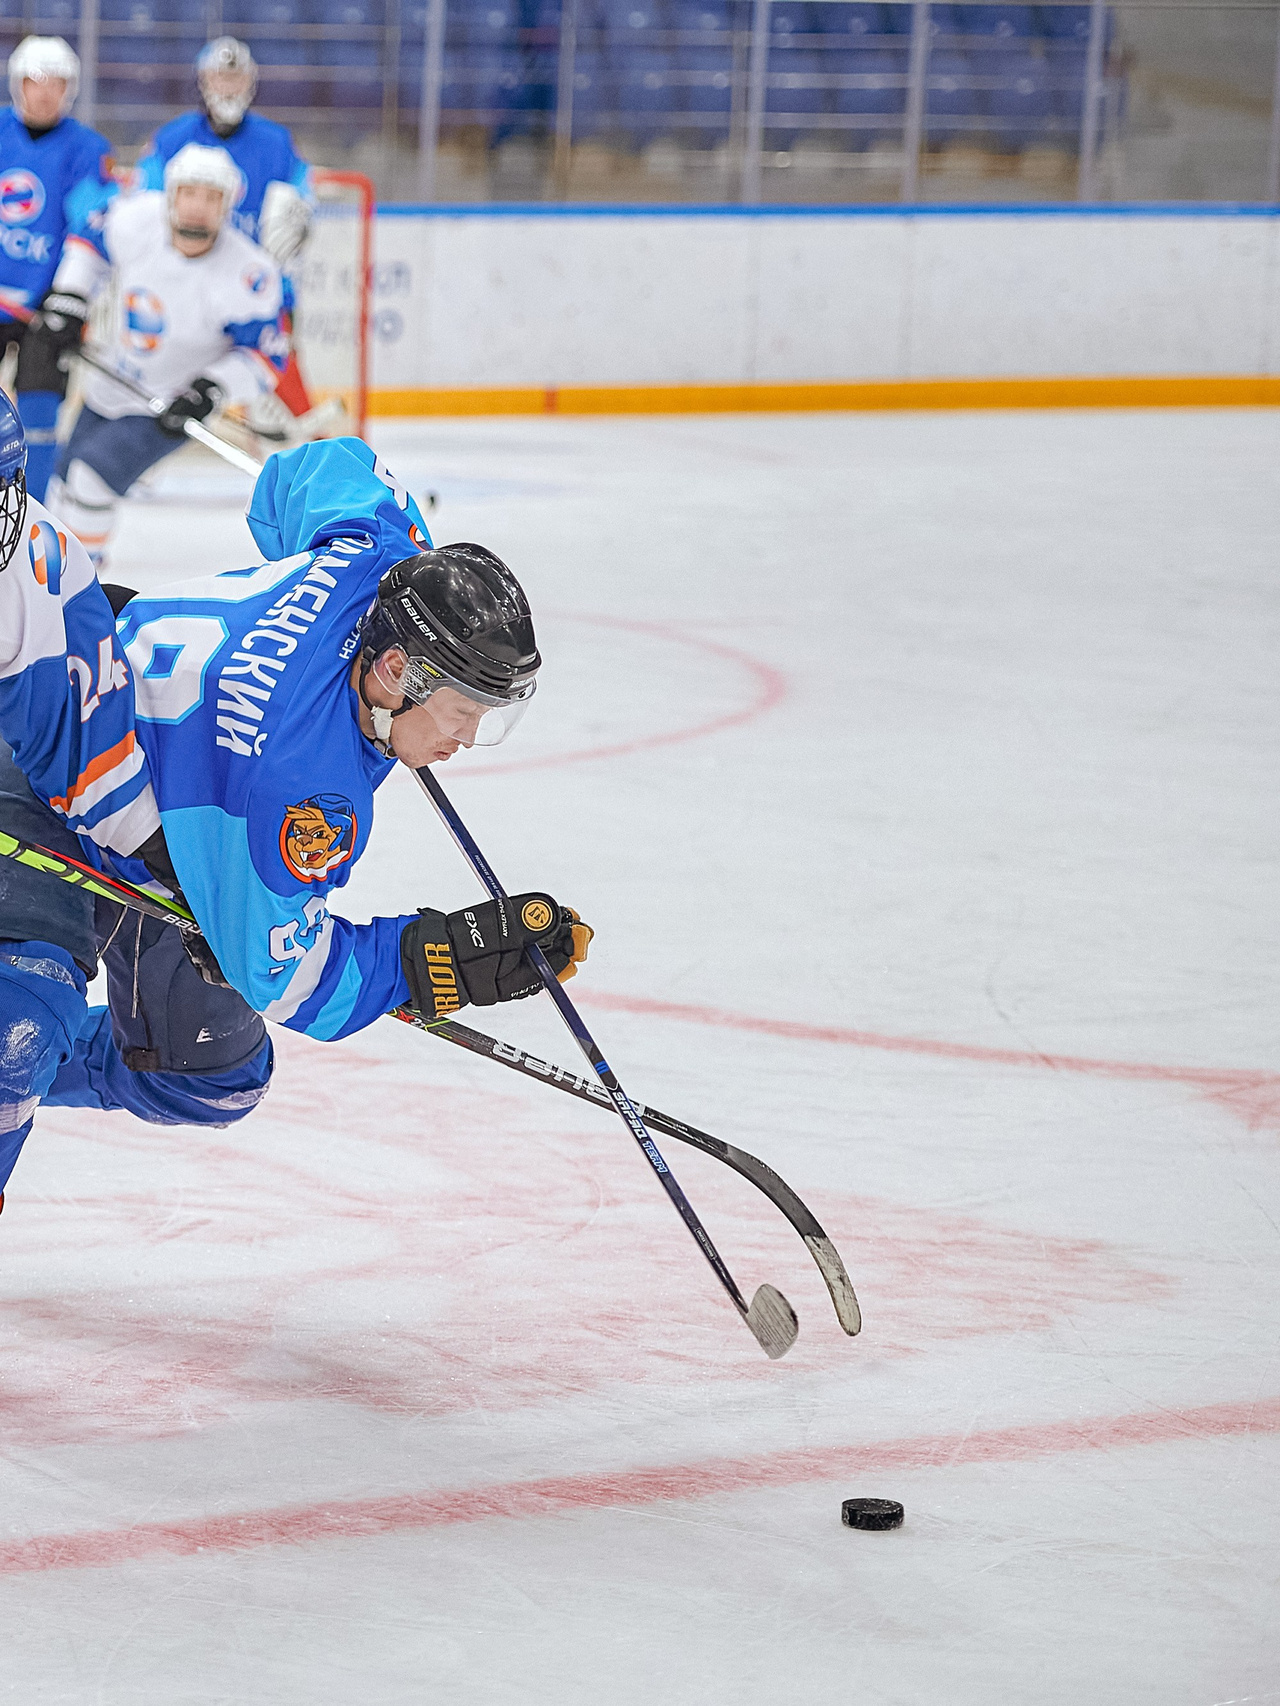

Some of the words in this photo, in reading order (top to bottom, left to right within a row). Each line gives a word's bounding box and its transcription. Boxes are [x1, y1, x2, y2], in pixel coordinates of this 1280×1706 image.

[401, 598, 438, 642] BAUER
[66, 634, 128, 723] 24
[162, 913, 204, 936] BAU
[642, 1140, 669, 1173] TEAM
